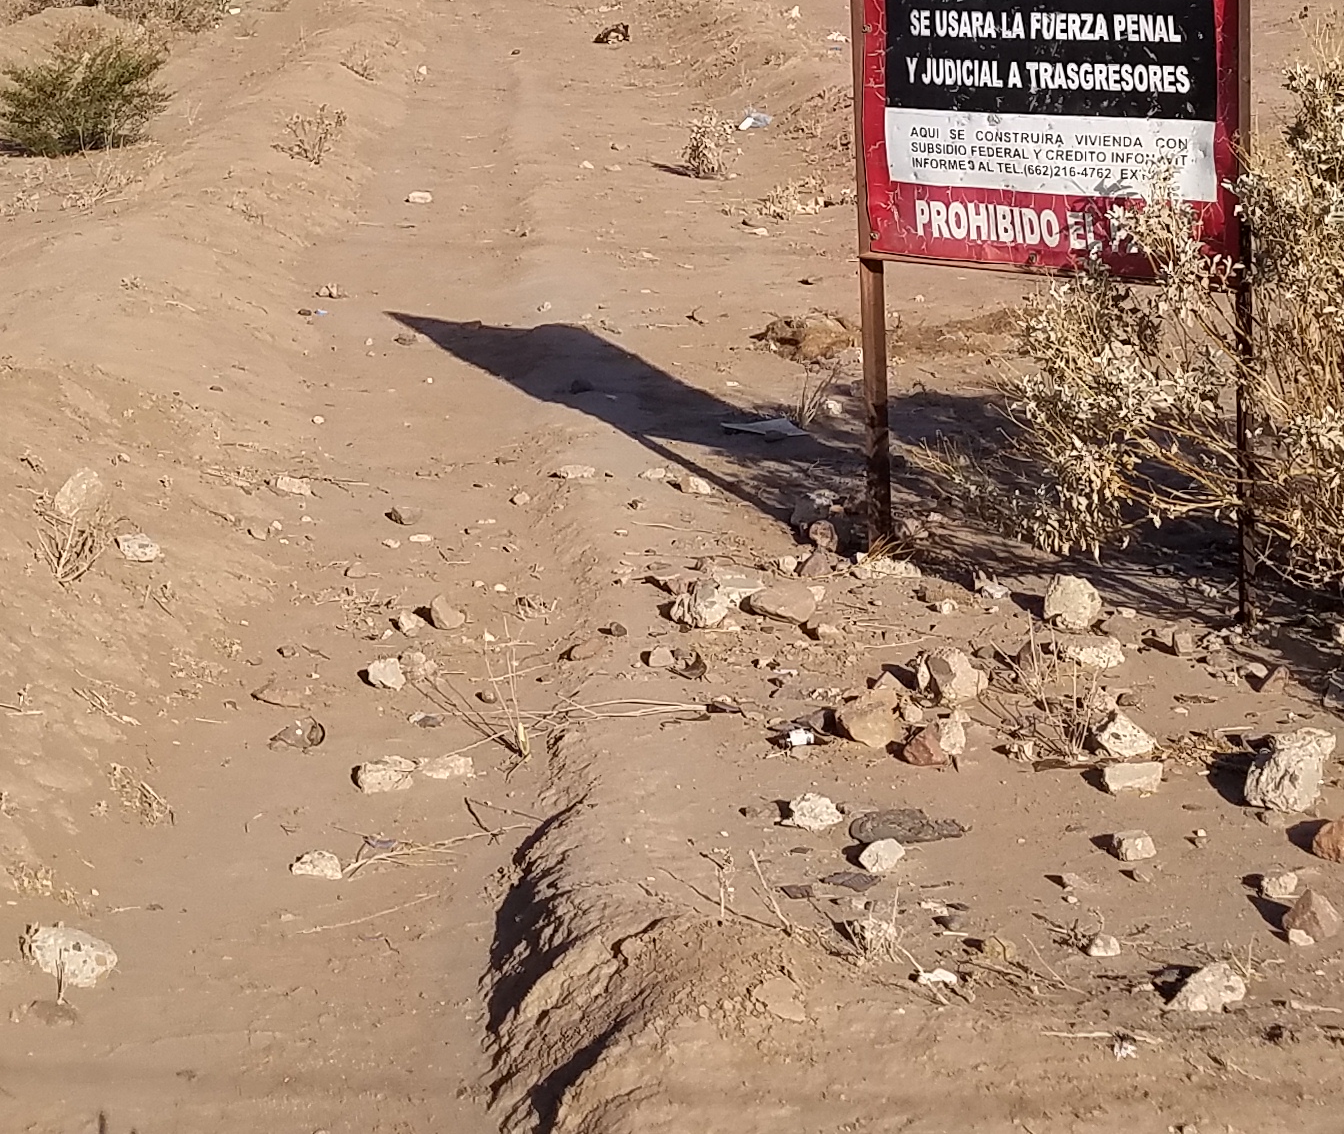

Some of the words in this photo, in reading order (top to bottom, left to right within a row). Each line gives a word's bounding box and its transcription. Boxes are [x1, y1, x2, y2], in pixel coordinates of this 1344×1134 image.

[910, 9, 930, 36] SE
[935, 9, 997, 39] USARA
[1001, 11, 1025, 39] LA
[1030, 12, 1109, 40] FUERZA
[1113, 14, 1182, 43] PENAL
[906, 56, 918, 83] Y
[921, 57, 1003, 88] JUDICIAL
[1007, 61, 1023, 88] A
[1025, 61, 1191, 94] TRASGRESORES
[910, 127, 939, 139] AQUI
[949, 129, 965, 140] SE
[975, 131, 1064, 145] CONSTRUIRA
[1075, 134, 1143, 147] VIVIENDA
[1156, 137, 1188, 150] CON
[911, 142, 967, 156] SUBSIDIO
[971, 146, 1029, 160] FEDERAL
[1033, 149, 1042, 160] Y
[1045, 150, 1106, 163] CREDITO
[978, 161, 994, 172] AL
[915, 199, 1060, 248] PROHIBIDO
